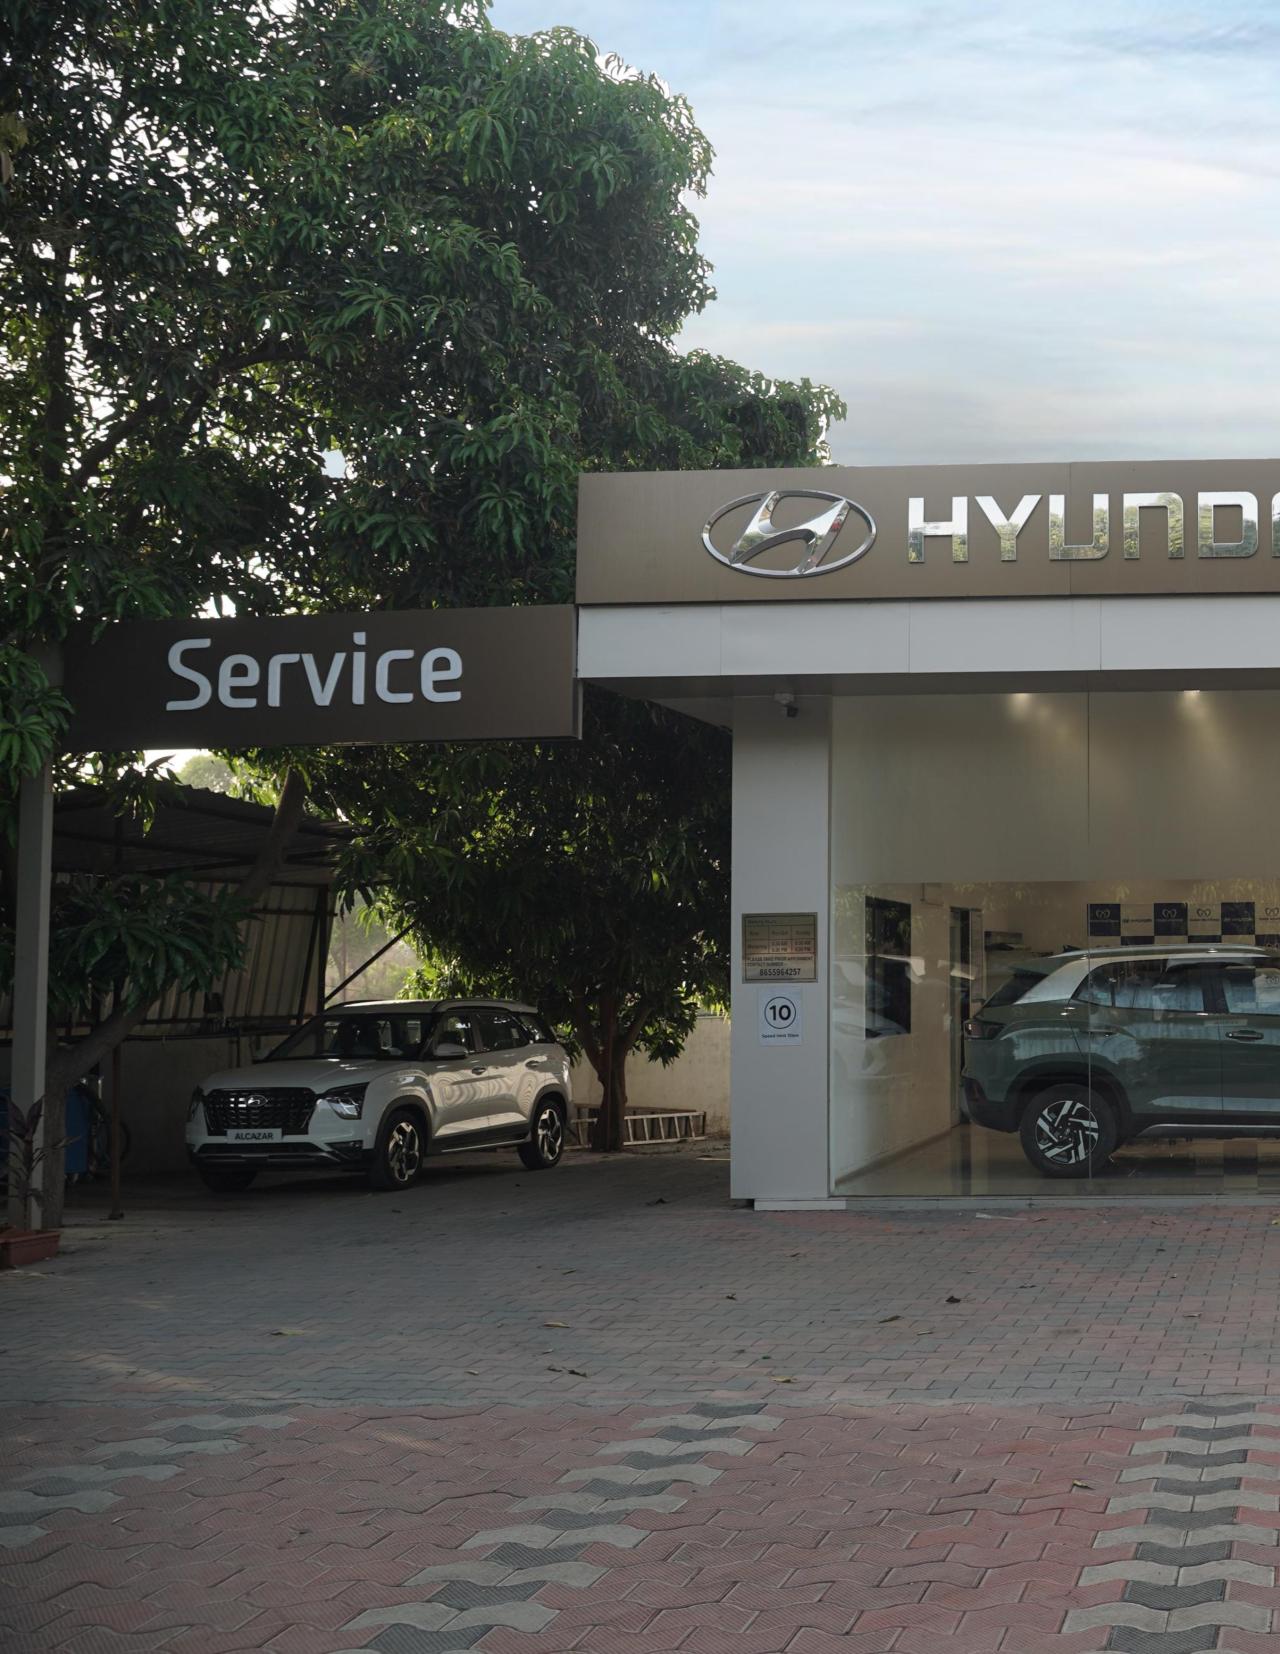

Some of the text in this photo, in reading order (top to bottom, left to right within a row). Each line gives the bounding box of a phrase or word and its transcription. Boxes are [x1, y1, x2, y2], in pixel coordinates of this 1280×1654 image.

[166, 631, 463, 711] Service
[769, 1005, 791, 1021] 10
[234, 1132, 274, 1140] ALCAZAR
